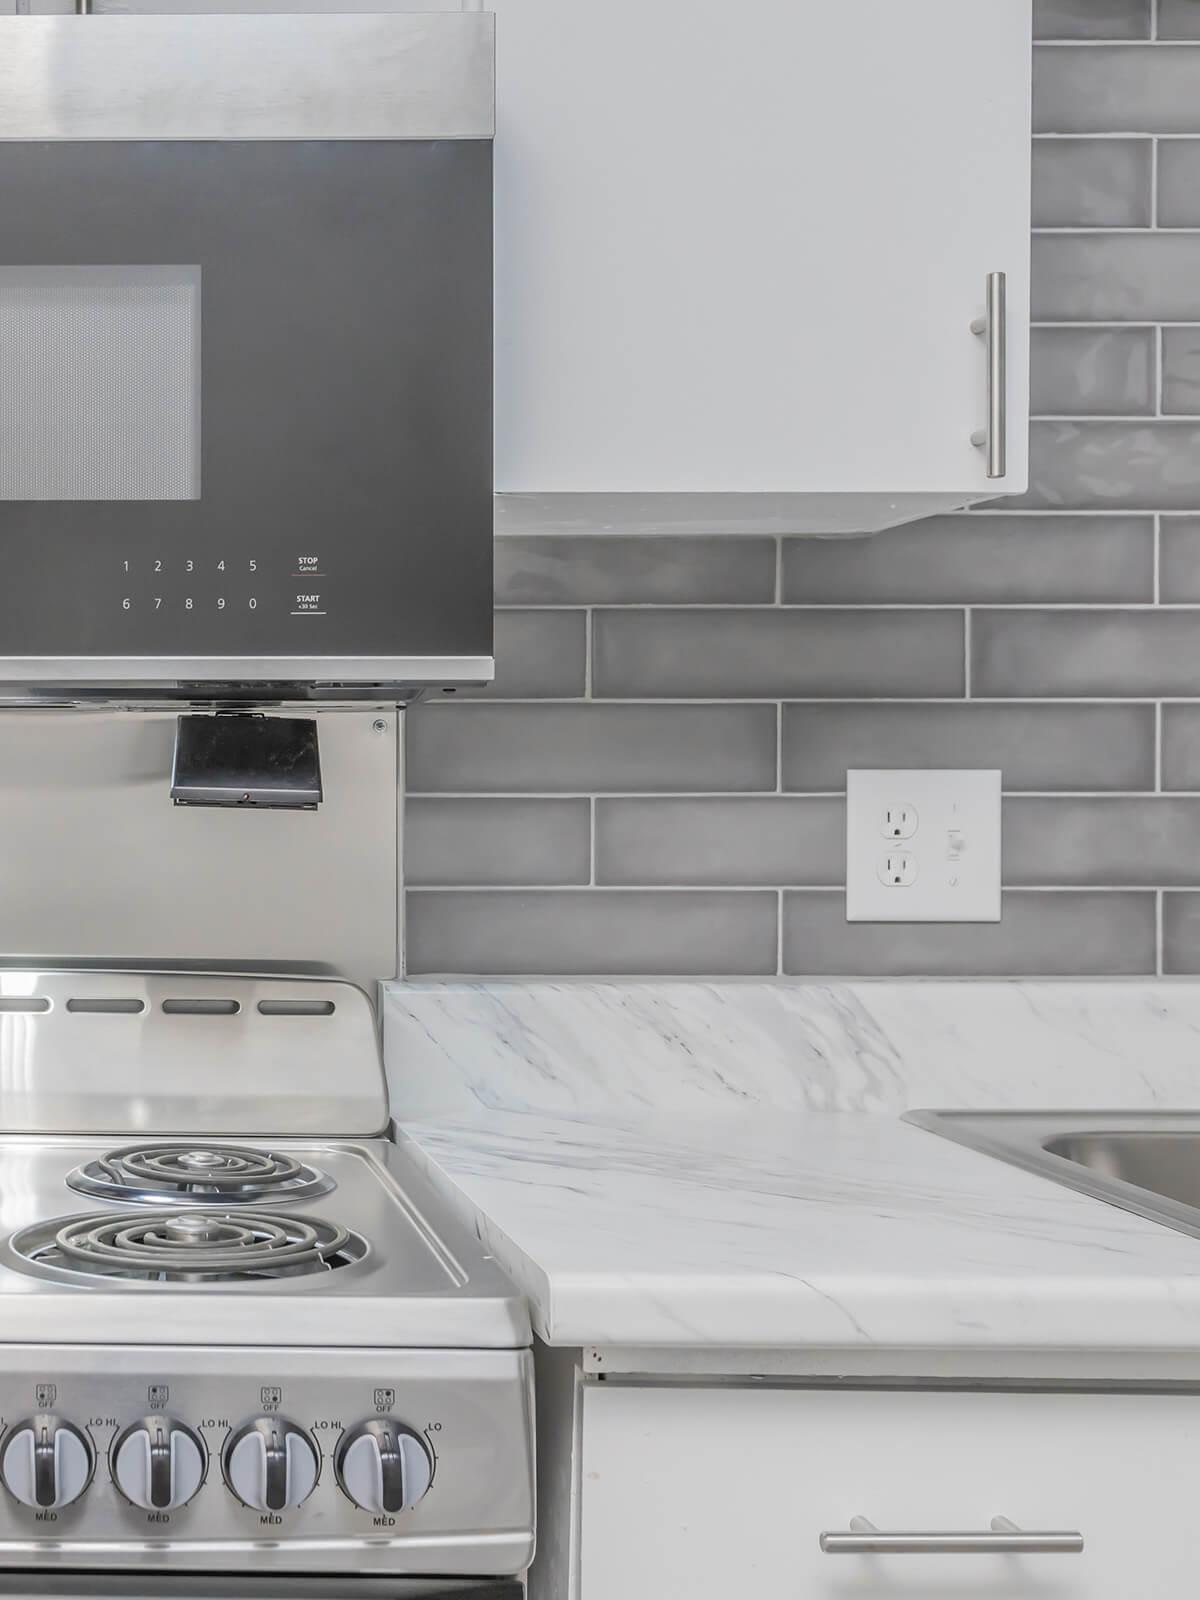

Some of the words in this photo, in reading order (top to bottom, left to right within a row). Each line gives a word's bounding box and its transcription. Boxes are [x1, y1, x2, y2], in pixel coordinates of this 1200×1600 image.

[123, 560, 129, 572] 1
[154, 560, 162, 572] 2
[186, 560, 194, 572] 3
[217, 560, 225, 572] 4
[249, 560, 257, 572] 5
[122, 598, 130, 609] 6
[154, 598, 162, 609] 7
[185, 598, 193, 609] 8
[217, 598, 225, 609] 9
[249, 598, 257, 609] 0
[376, 1405, 392, 1413] OFF
[89, 1418, 103, 1426] LO
[105, 1418, 116, 1426] HI
[202, 1419, 215, 1427] LO
[218, 1420, 229, 1428] HI
[315, 1421, 329, 1429] LO
[331, 1421, 342, 1429] HI
[428, 1423, 442, 1431] LO
[35, 1512, 58, 1521] MED
[147, 1513, 170, 1523] MED
[260, 1516, 283, 1525] MED
[373, 1518, 396, 1526] MED
